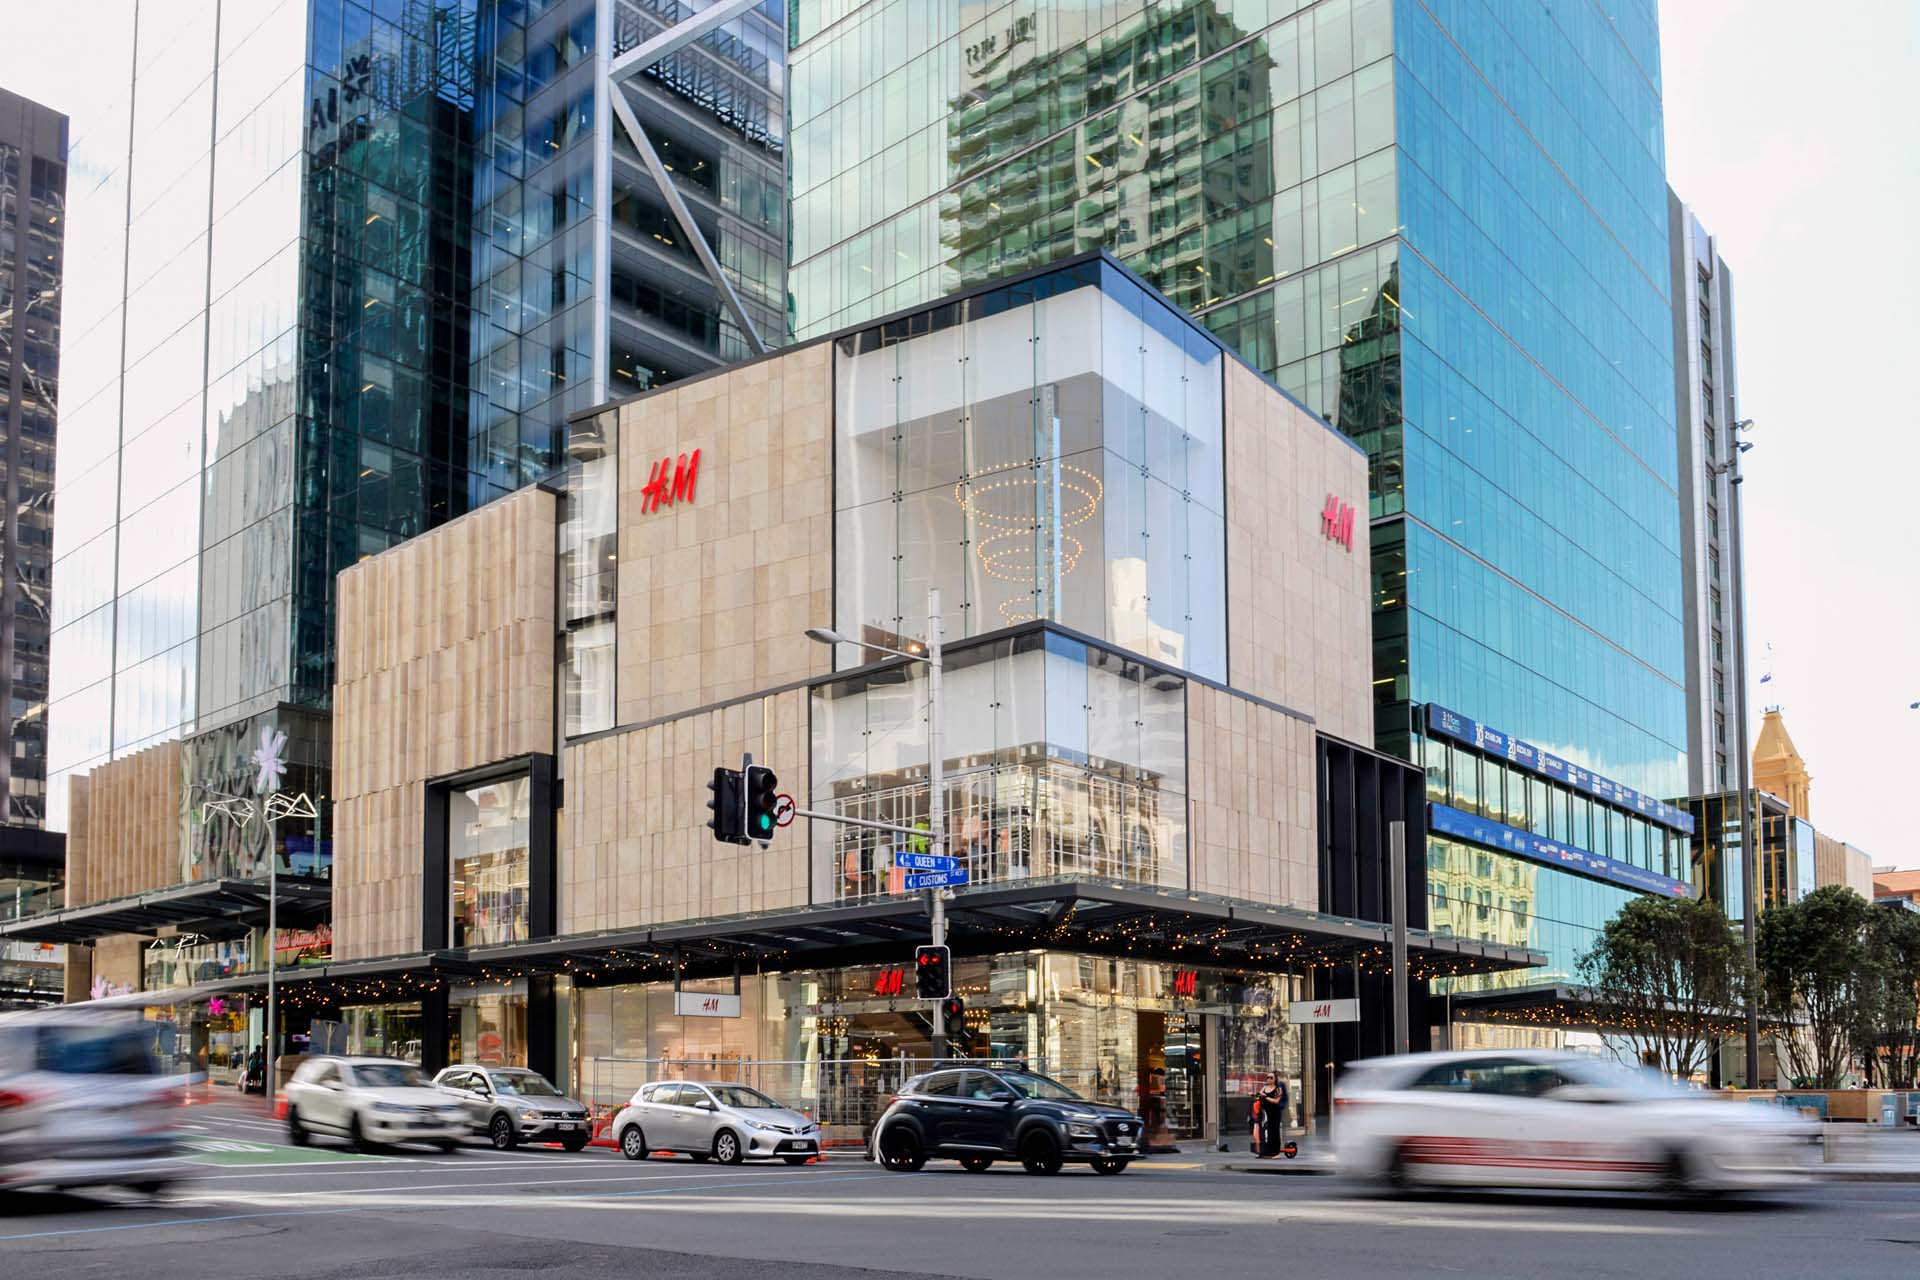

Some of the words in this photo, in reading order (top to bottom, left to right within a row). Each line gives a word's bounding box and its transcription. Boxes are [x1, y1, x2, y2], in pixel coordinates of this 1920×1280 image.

[641, 448, 701, 514] H&M
[1321, 493, 1355, 553] H&M
[914, 857, 936, 868] QUEEN
[919, 873, 948, 886] CUSTOMS
